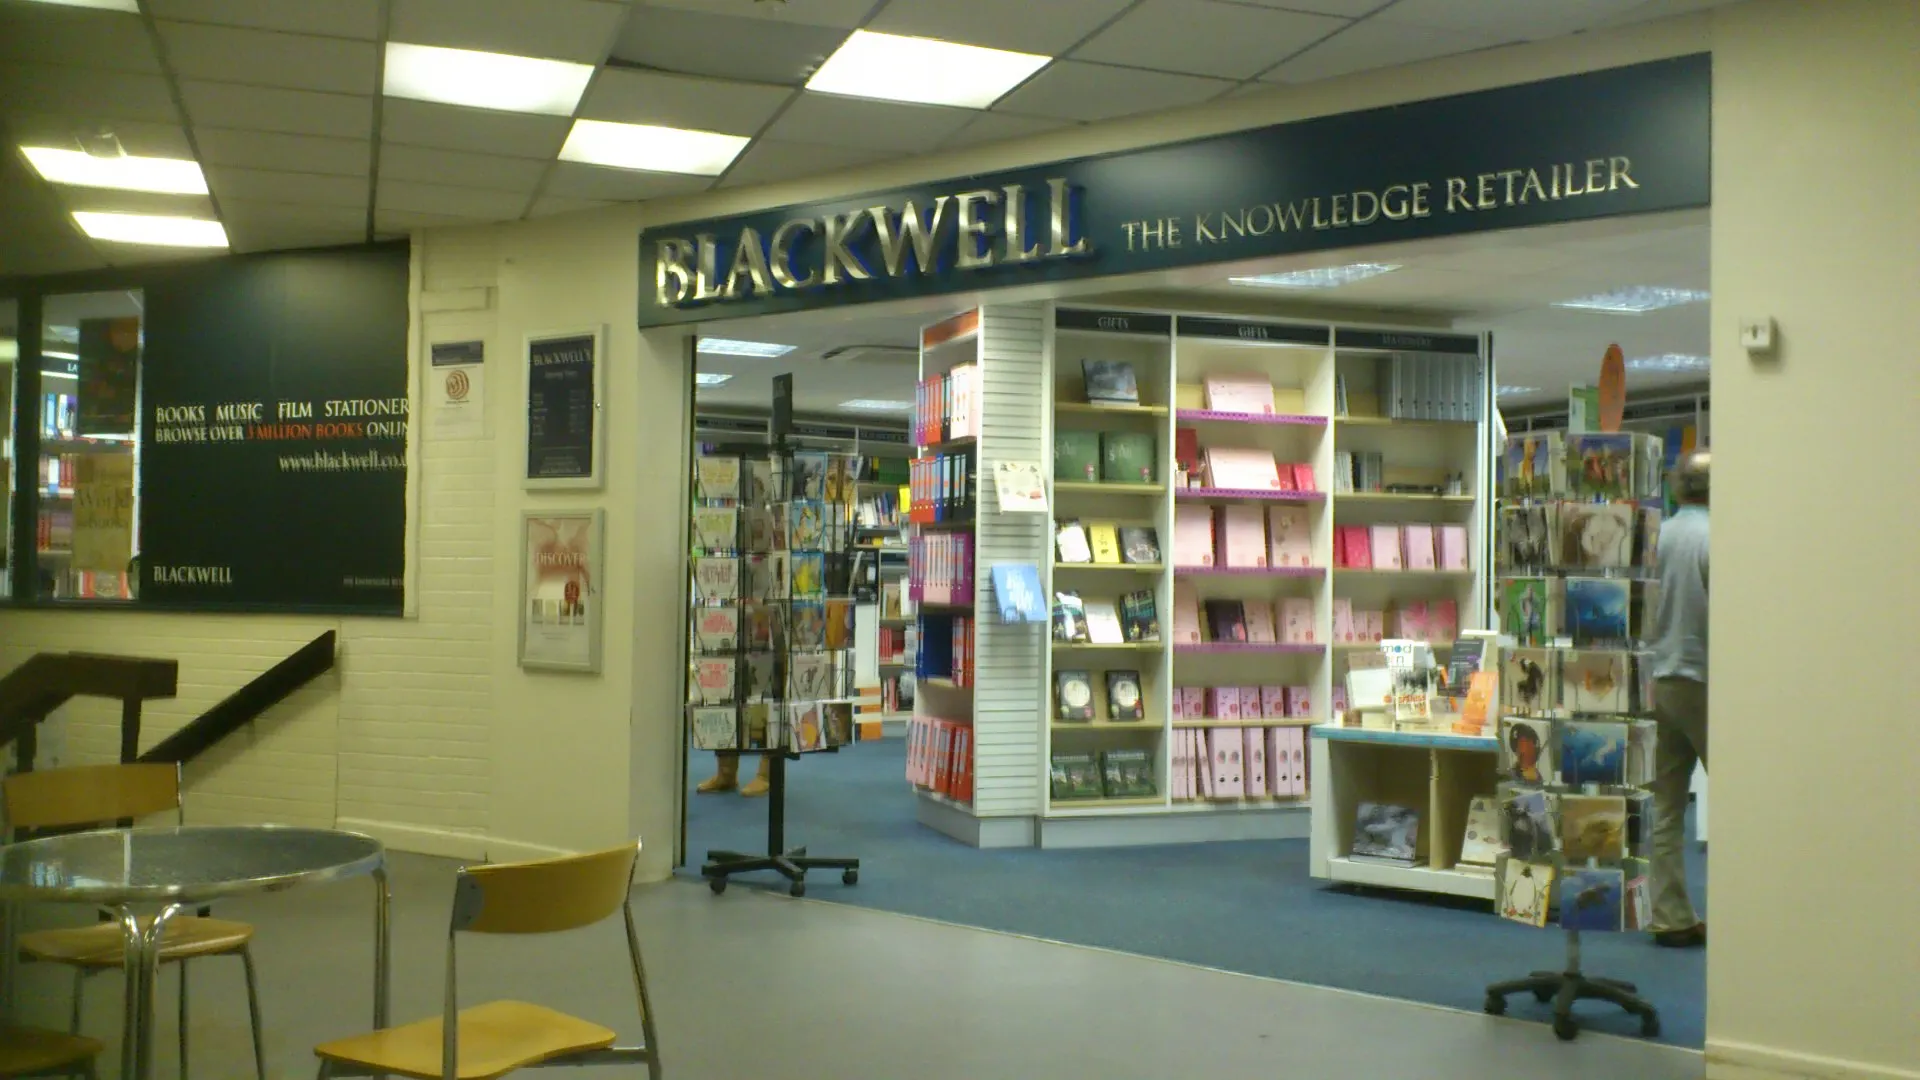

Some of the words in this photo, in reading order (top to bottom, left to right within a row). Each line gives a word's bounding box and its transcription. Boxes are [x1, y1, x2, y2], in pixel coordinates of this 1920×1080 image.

[1121, 217, 1182, 252] THE
[1195, 181, 1432, 243] KNOWLEDGE
[1446, 156, 1640, 211] RETAILER
[656, 178, 1089, 307] BLACKWELL
[1098, 316, 1130, 331] GIFTS
[156, 404, 205, 423] BOOKS
[215, 403, 263, 421] MUSIC
[278, 401, 313, 419] FILM
[155, 425, 207, 442] BROWSE
[209, 425, 244, 442] OVER
[257, 424, 311, 441] MILLION
[316, 423, 362, 440] BOOKS
[536, 551, 586, 566] DISCOVER
[153, 566, 233, 584] BLACKWELL
